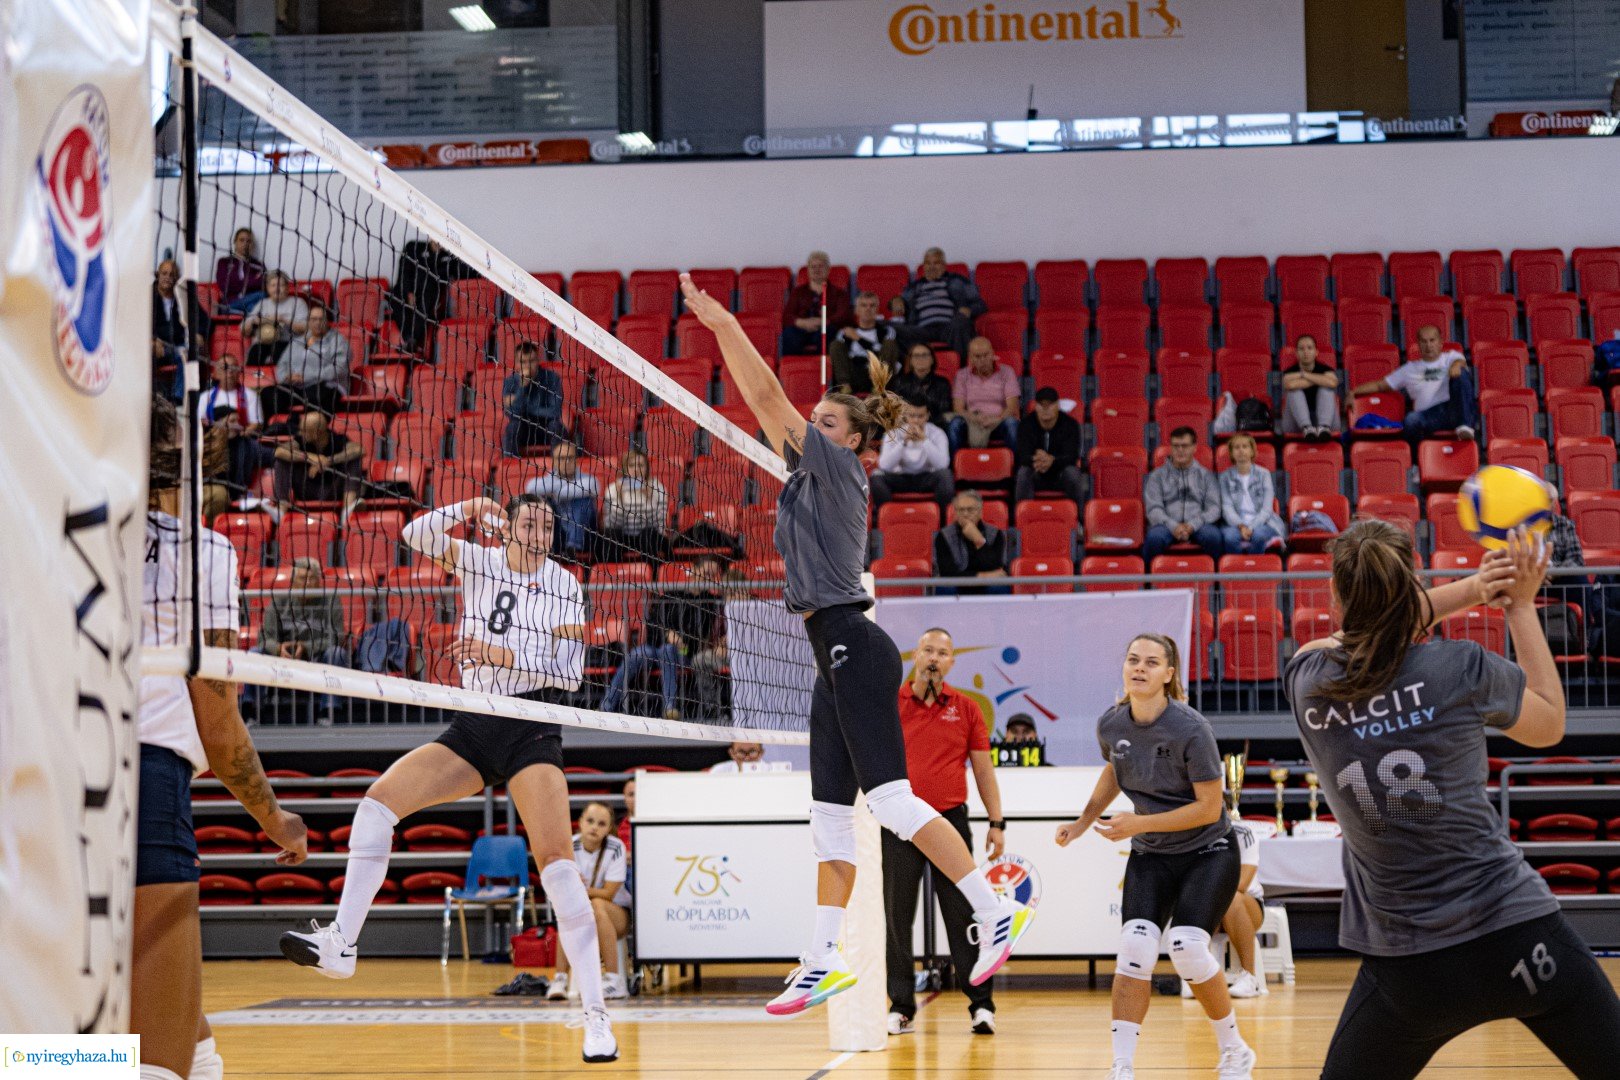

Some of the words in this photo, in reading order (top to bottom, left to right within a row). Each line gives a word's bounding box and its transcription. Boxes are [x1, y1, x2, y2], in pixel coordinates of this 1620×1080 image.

[889, 2, 1140, 55] Continental
[1367, 115, 1455, 138] Continental
[439, 143, 526, 163] Continental
[487, 590, 517, 635] 8
[1304, 681, 1425, 730] CALCIT
[1353, 706, 1436, 740] VOLLEY
[1021, 746, 1040, 768] 14
[1336, 749, 1443, 834] 18
[1510, 942, 1557, 995] 18
